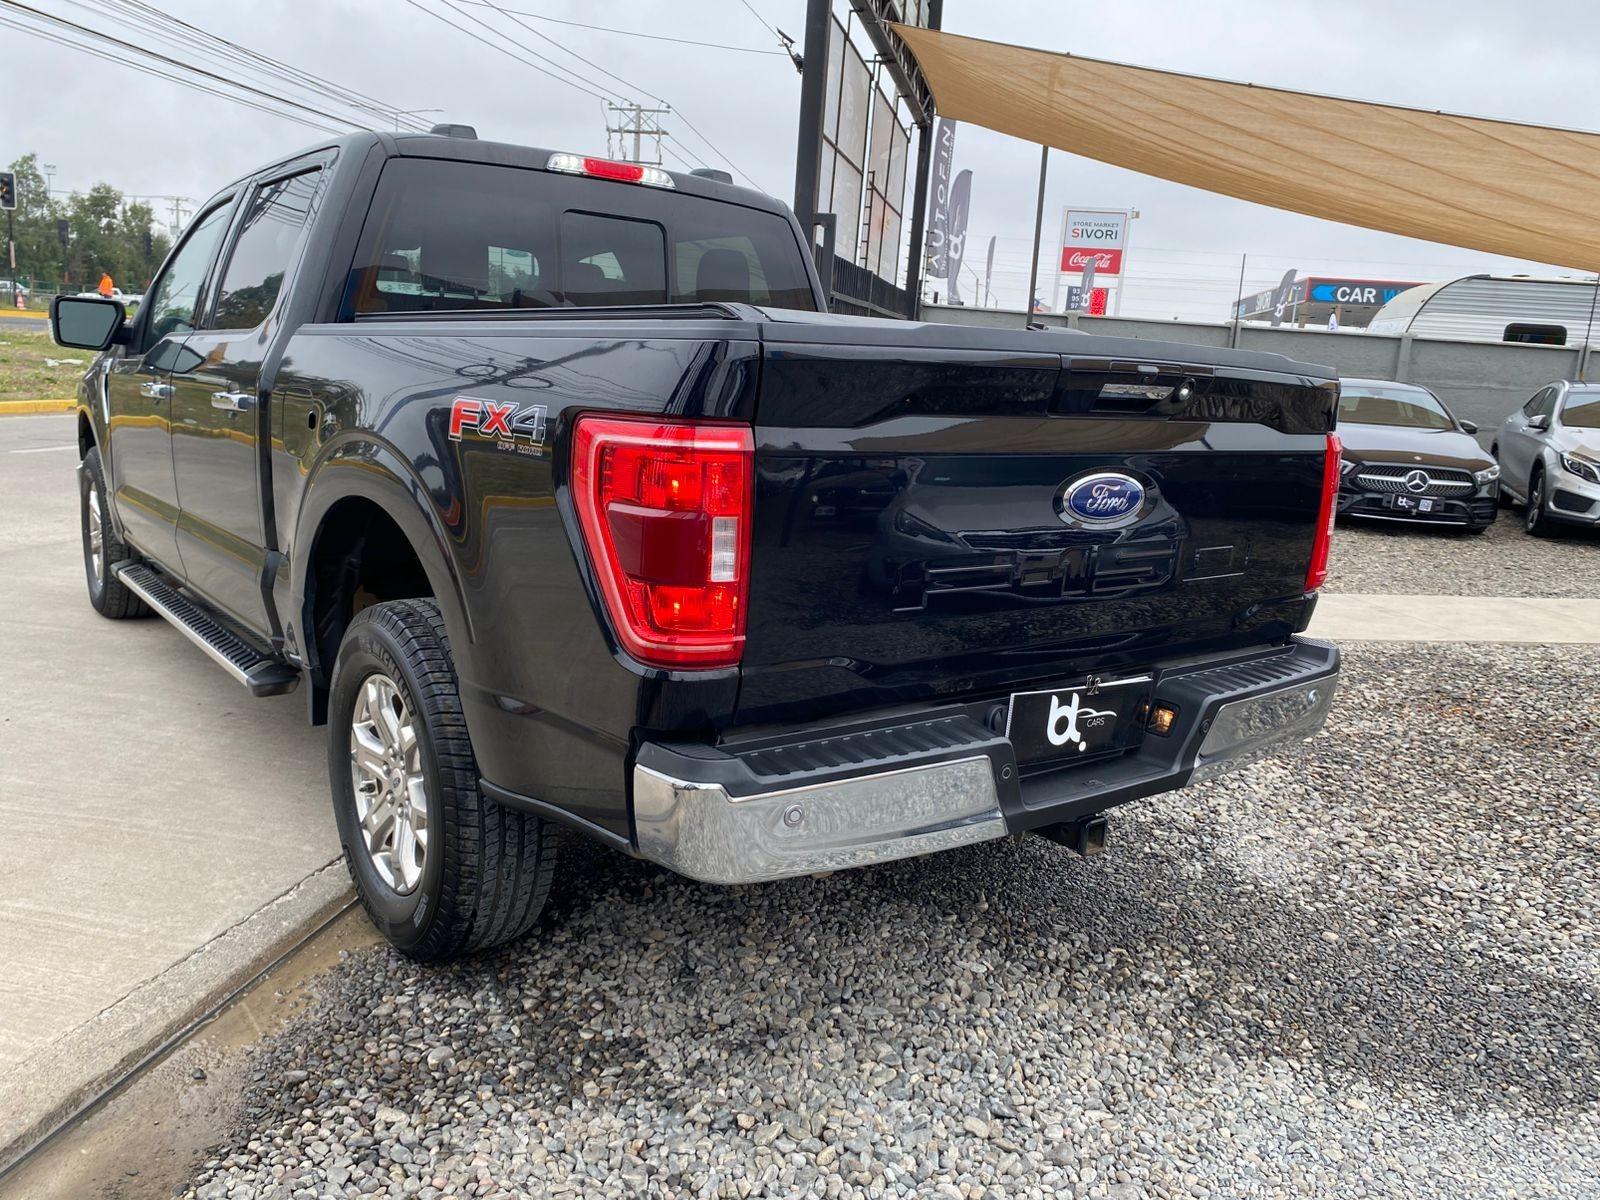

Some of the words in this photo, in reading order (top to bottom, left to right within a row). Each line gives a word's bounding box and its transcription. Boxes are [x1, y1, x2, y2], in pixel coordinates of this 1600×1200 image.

[1071, 228, 1118, 240] SIVORI
[1069, 251, 1114, 268] Cocaola
[1336, 286, 1377, 303] CAR
[448, 396, 547, 446] FX4
[1086, 484, 1131, 512] Ford
[1086, 717, 1105, 727] CARS
